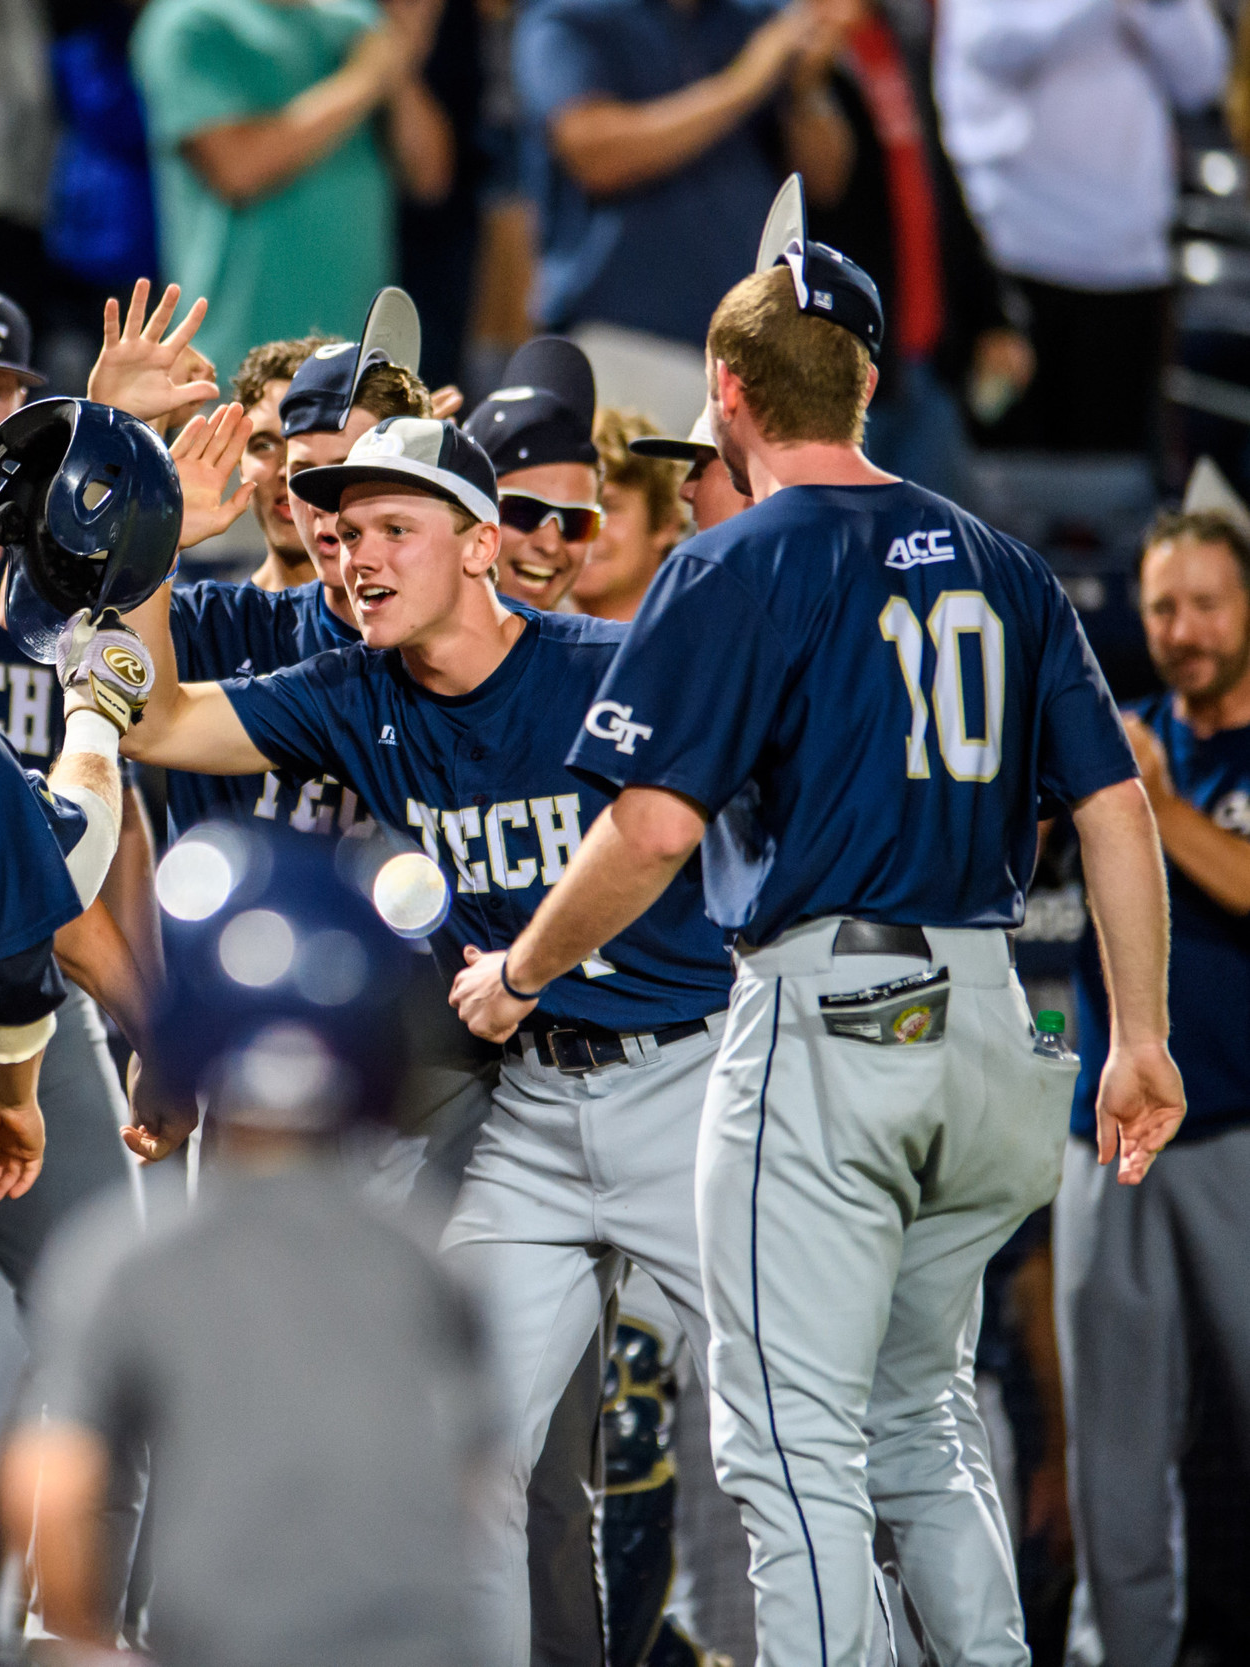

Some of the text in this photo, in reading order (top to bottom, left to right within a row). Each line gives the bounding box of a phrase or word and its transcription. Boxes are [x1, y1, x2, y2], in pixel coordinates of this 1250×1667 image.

[885, 529, 955, 570] ACC
[878, 590, 1006, 784] 10
[585, 700, 654, 756] GT
[405, 793, 585, 894] TECH
